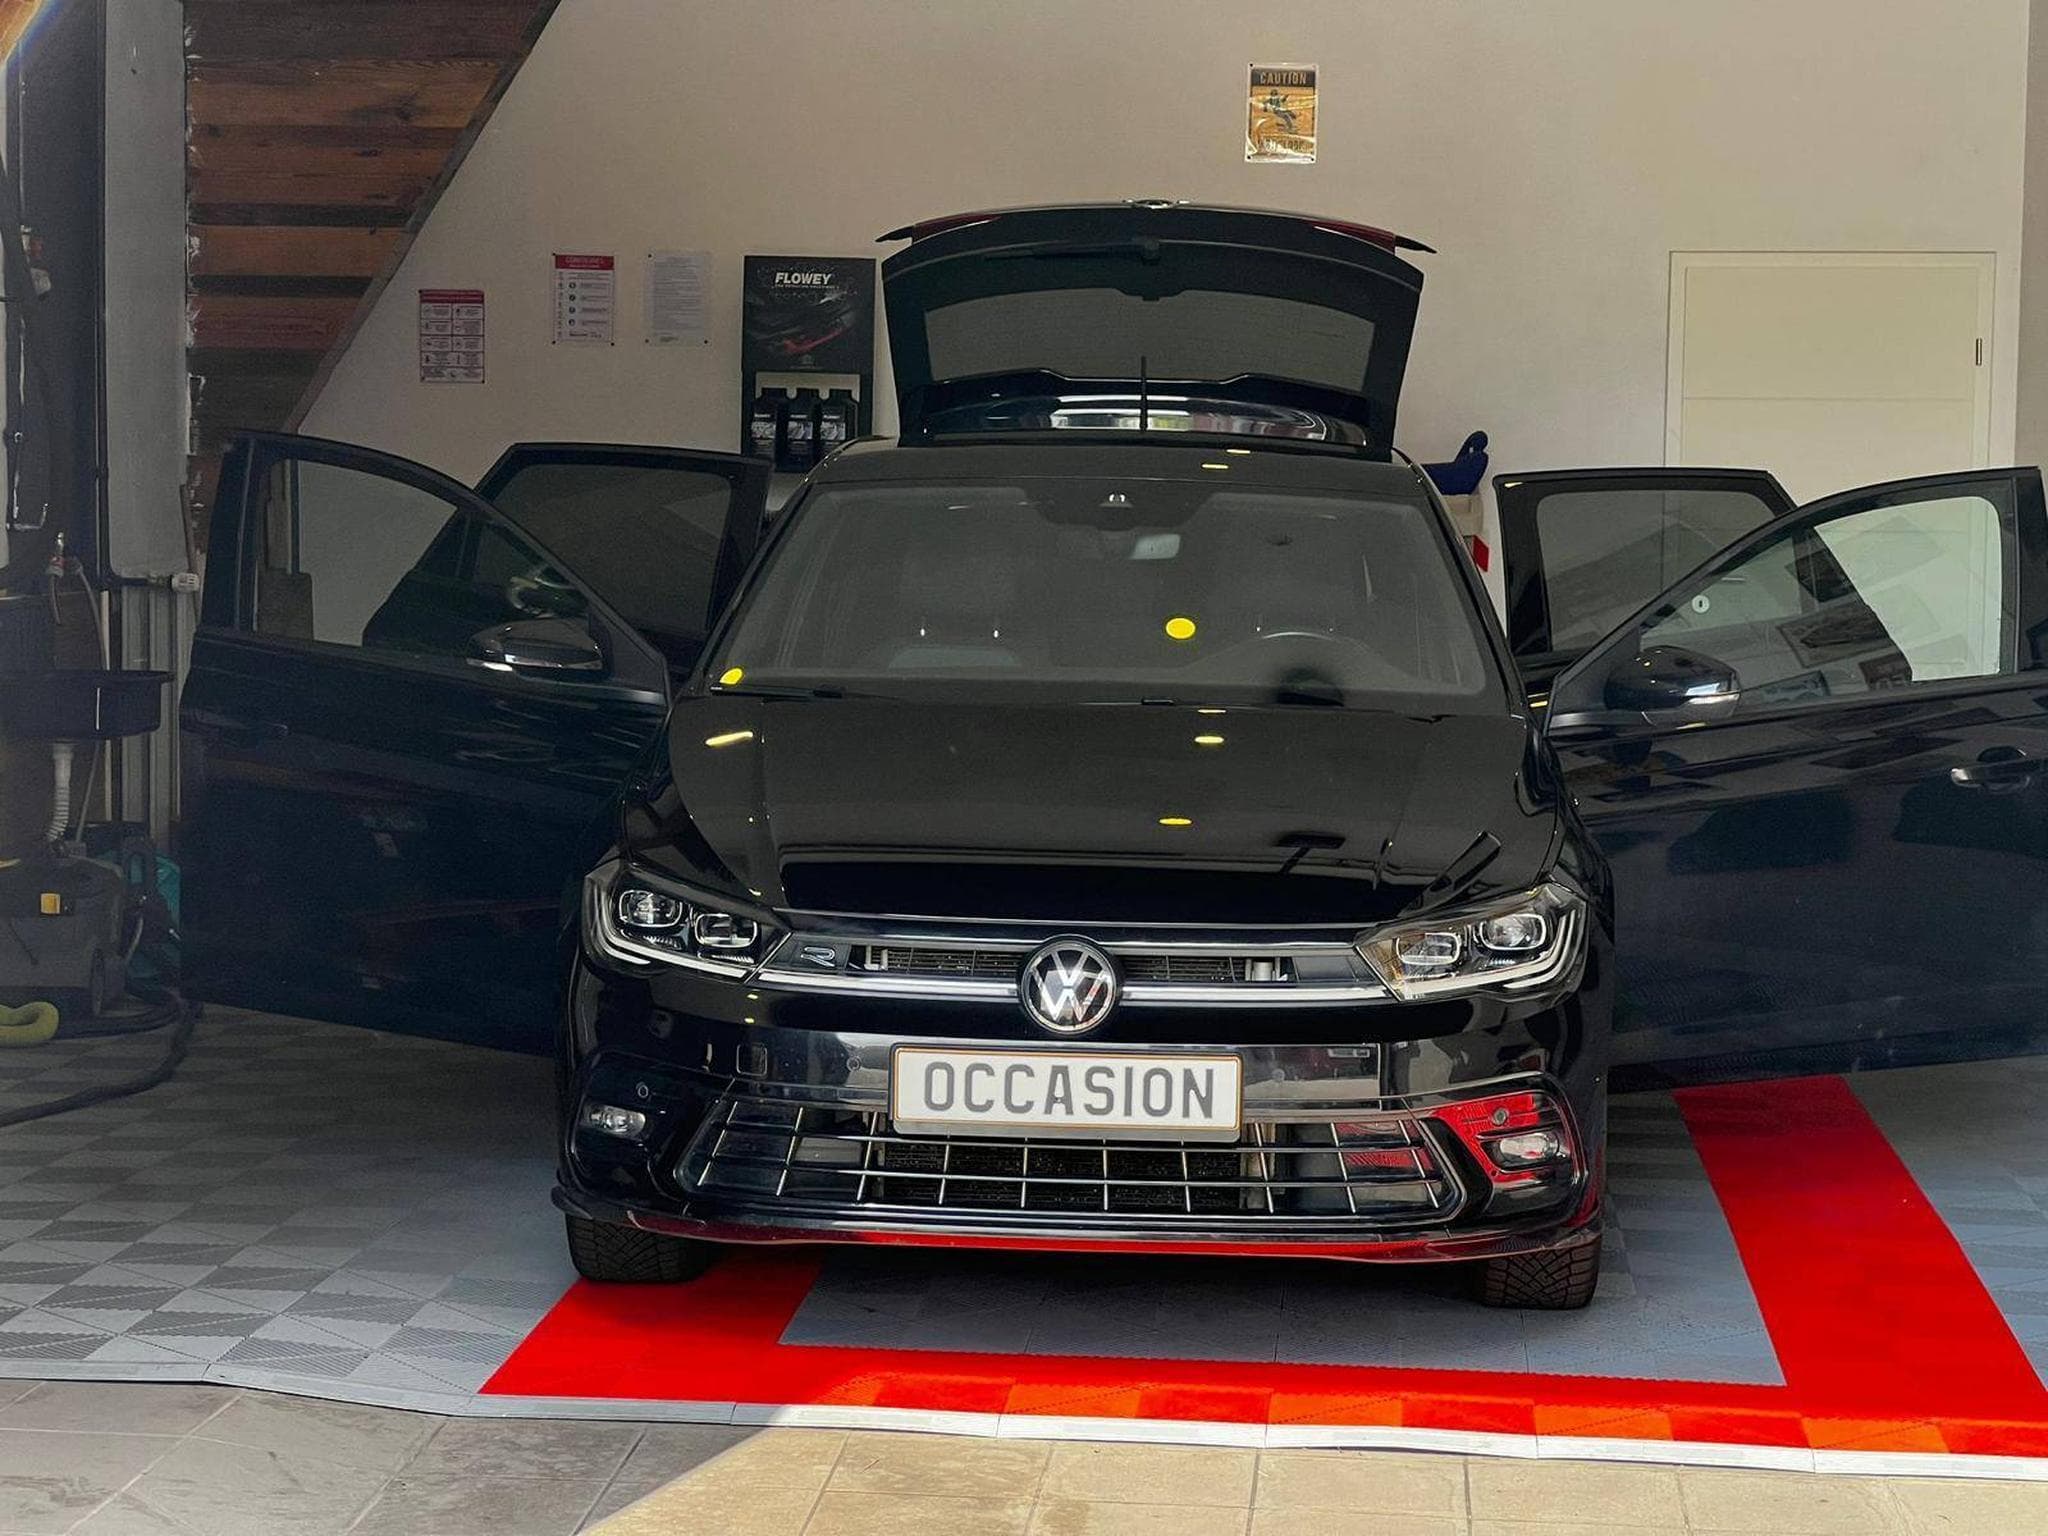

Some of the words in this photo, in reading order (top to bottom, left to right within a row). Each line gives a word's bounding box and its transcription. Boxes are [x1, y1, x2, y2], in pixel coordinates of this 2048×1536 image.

[1260, 72, 1306, 84] CAUTION
[775, 272, 832, 285] FLOWEY
[924, 1061, 1214, 1118] OCCASION
